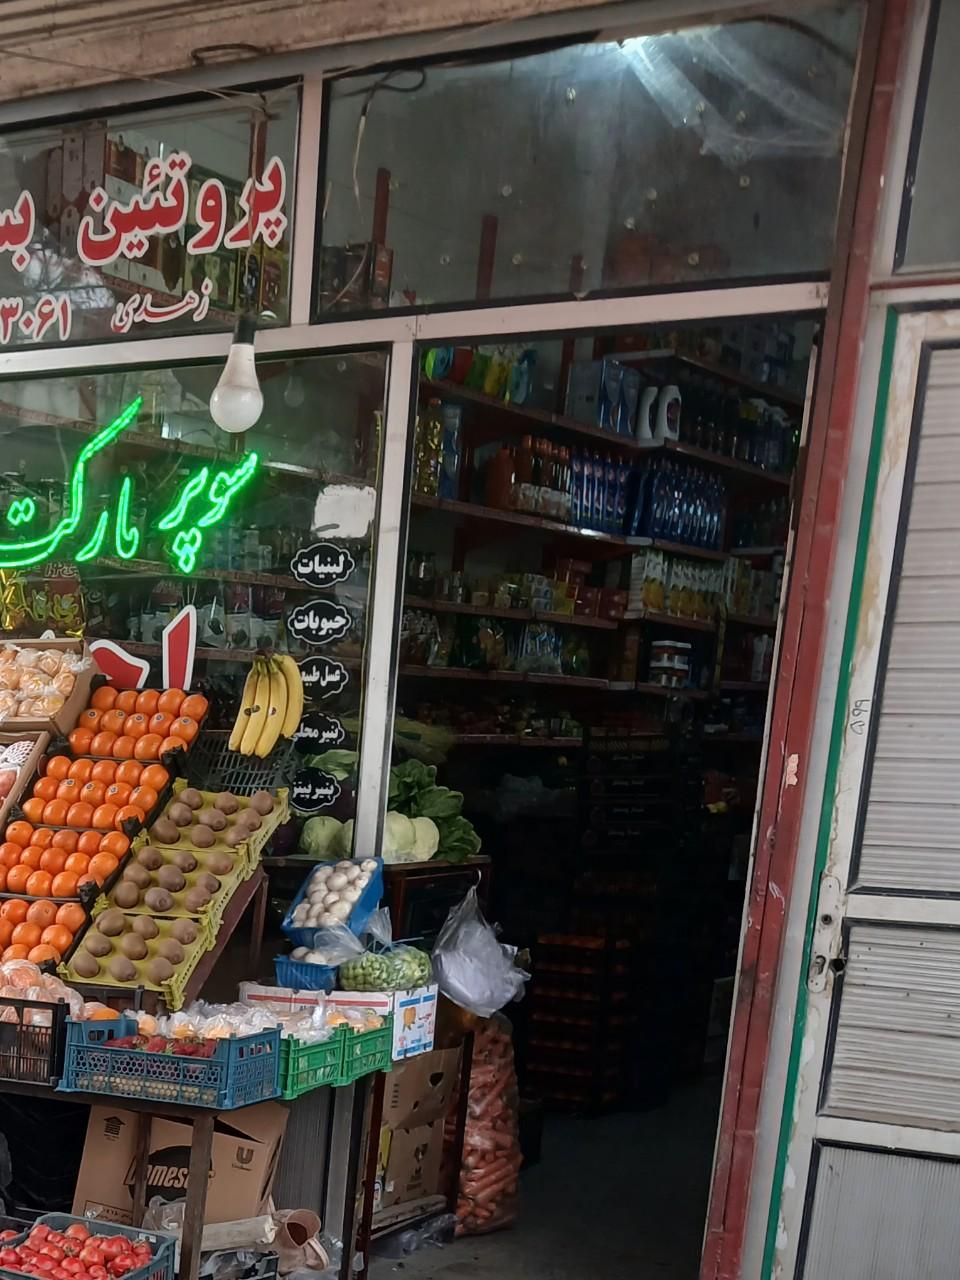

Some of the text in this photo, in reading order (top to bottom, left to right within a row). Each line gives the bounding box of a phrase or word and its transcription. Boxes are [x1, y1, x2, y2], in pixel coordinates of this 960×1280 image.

[77, 152, 288, 266] پروتئین
[158, 453, 259, 574] سوپر
[297, 554, 345, 580] لبنیات
[293, 609, 347, 636] حبوبات
